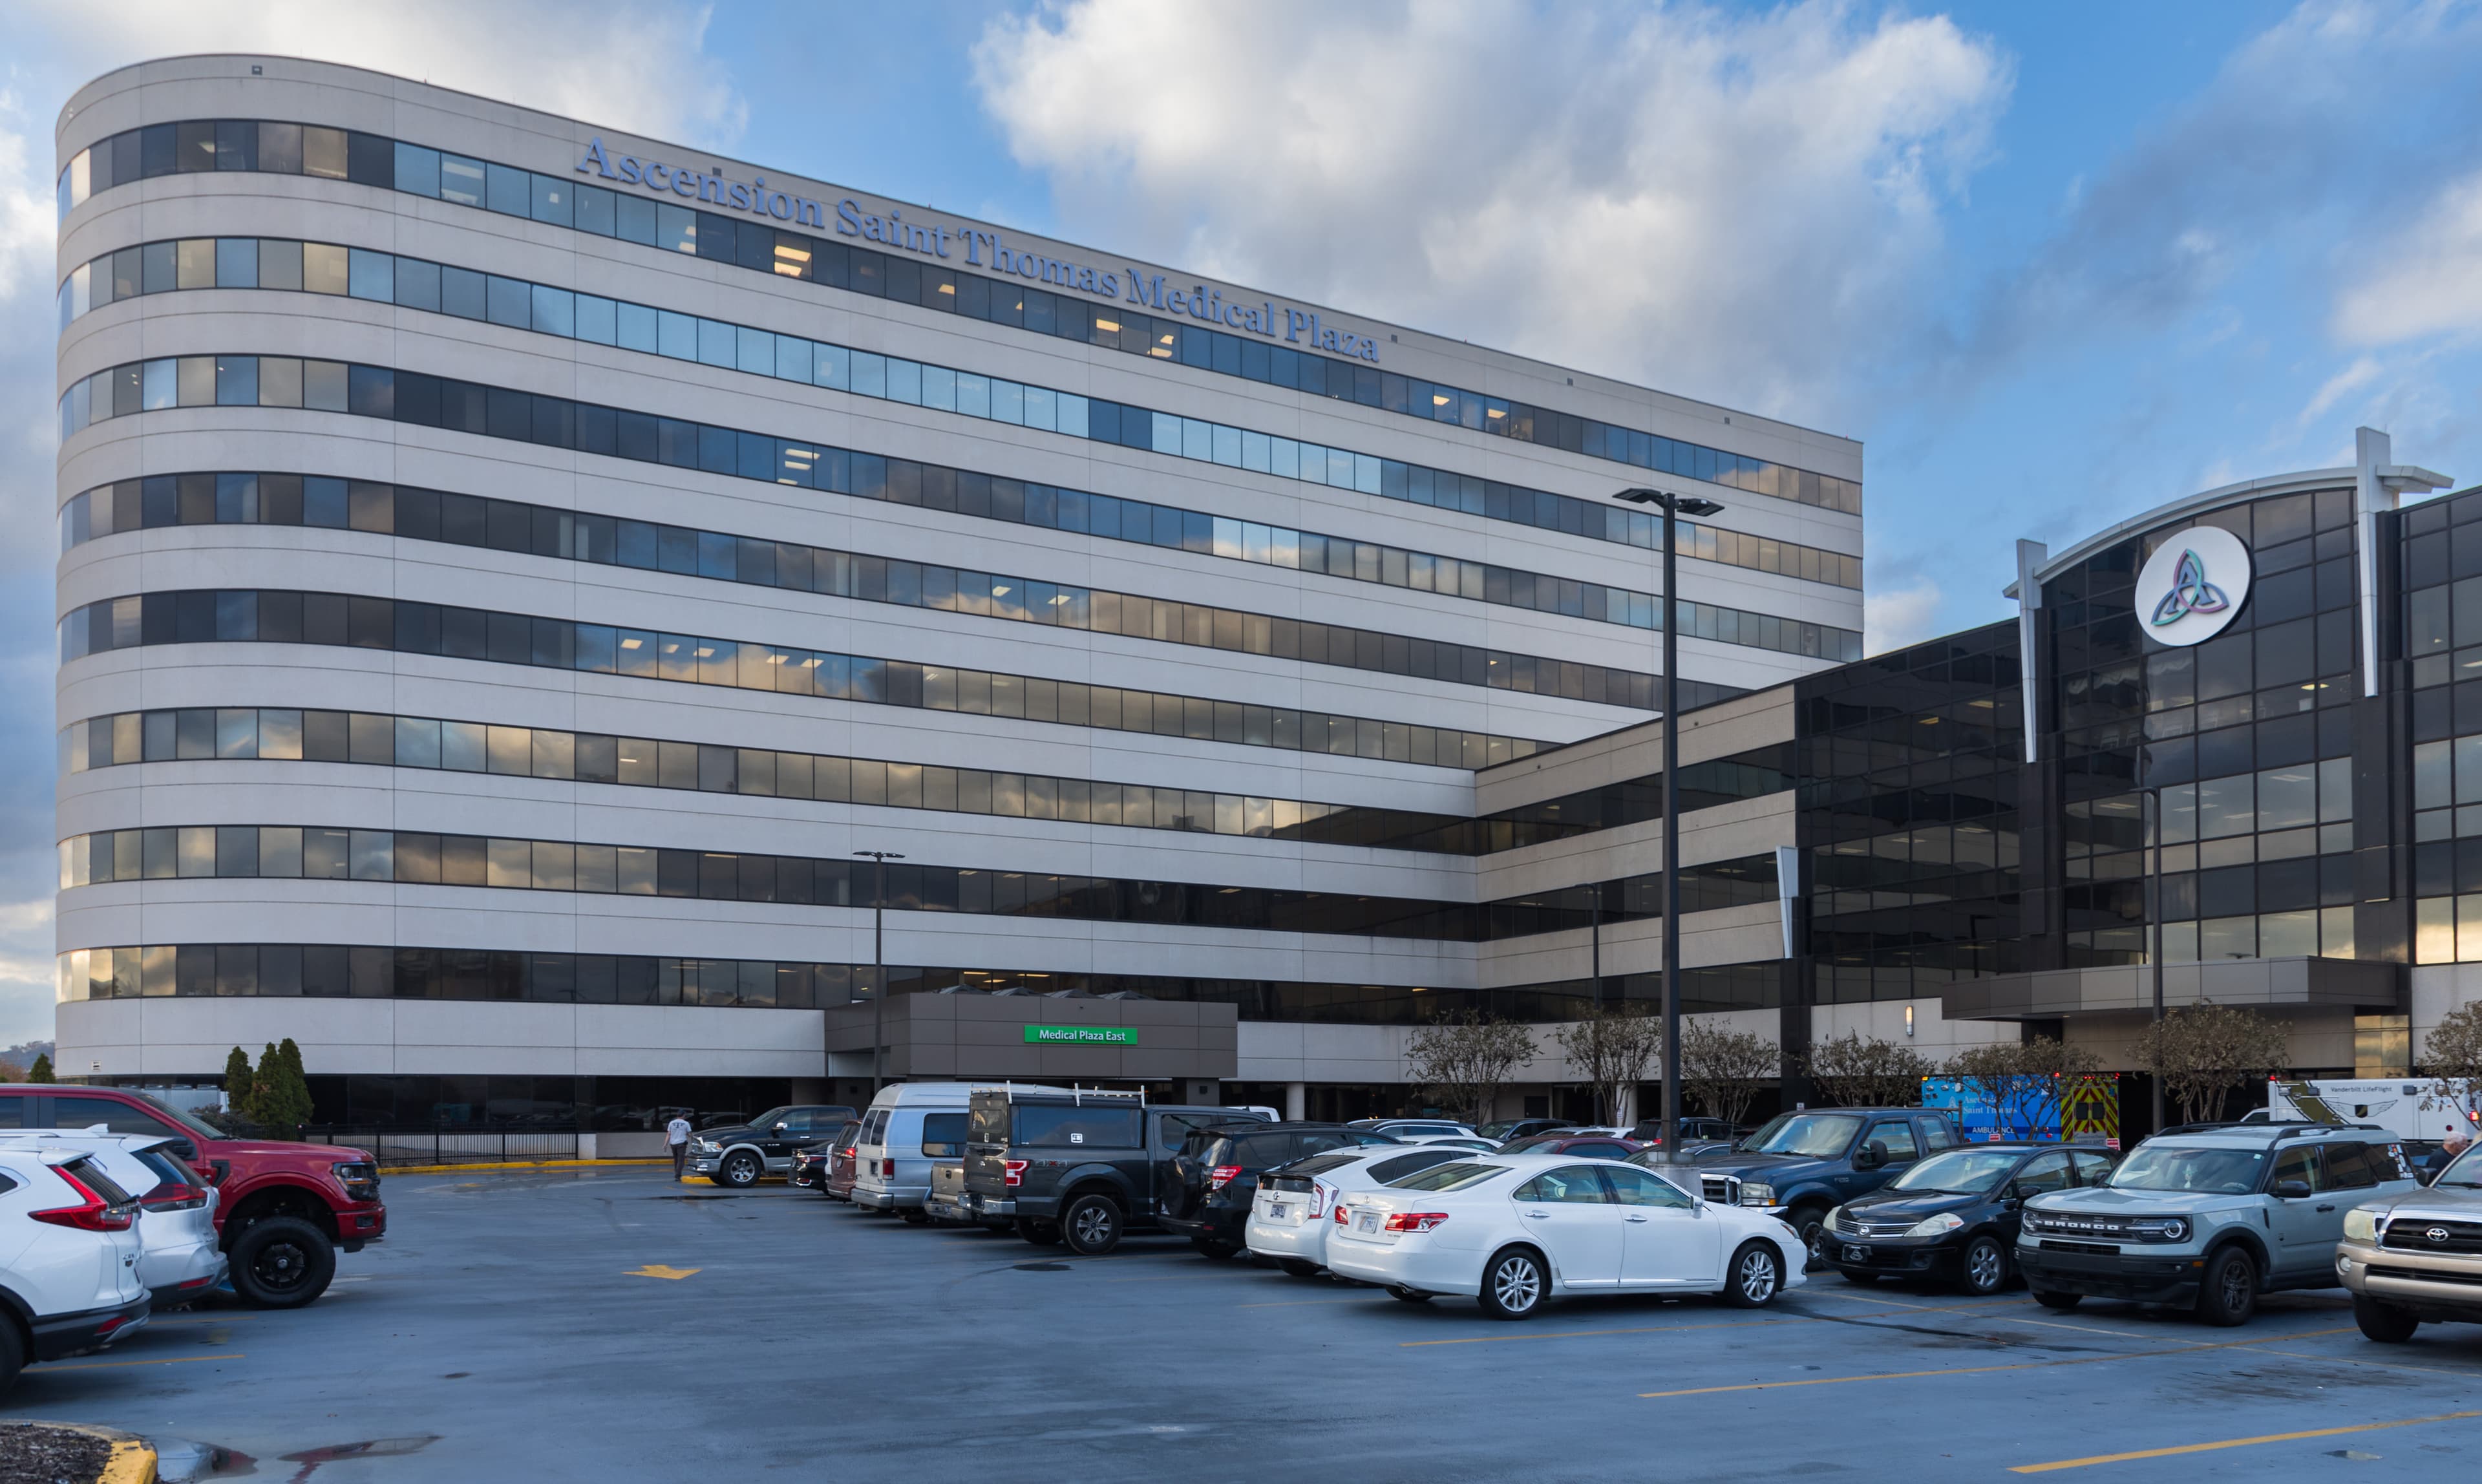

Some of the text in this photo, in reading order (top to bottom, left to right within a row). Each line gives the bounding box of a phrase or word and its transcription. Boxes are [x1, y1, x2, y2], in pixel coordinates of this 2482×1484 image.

[576, 136, 1379, 363] Ascension Saint Thomas Medical Plaza
[1039, 1029, 1126, 1041] Medical Plaza East
[2044, 1220, 2119, 1230] BRONCO
